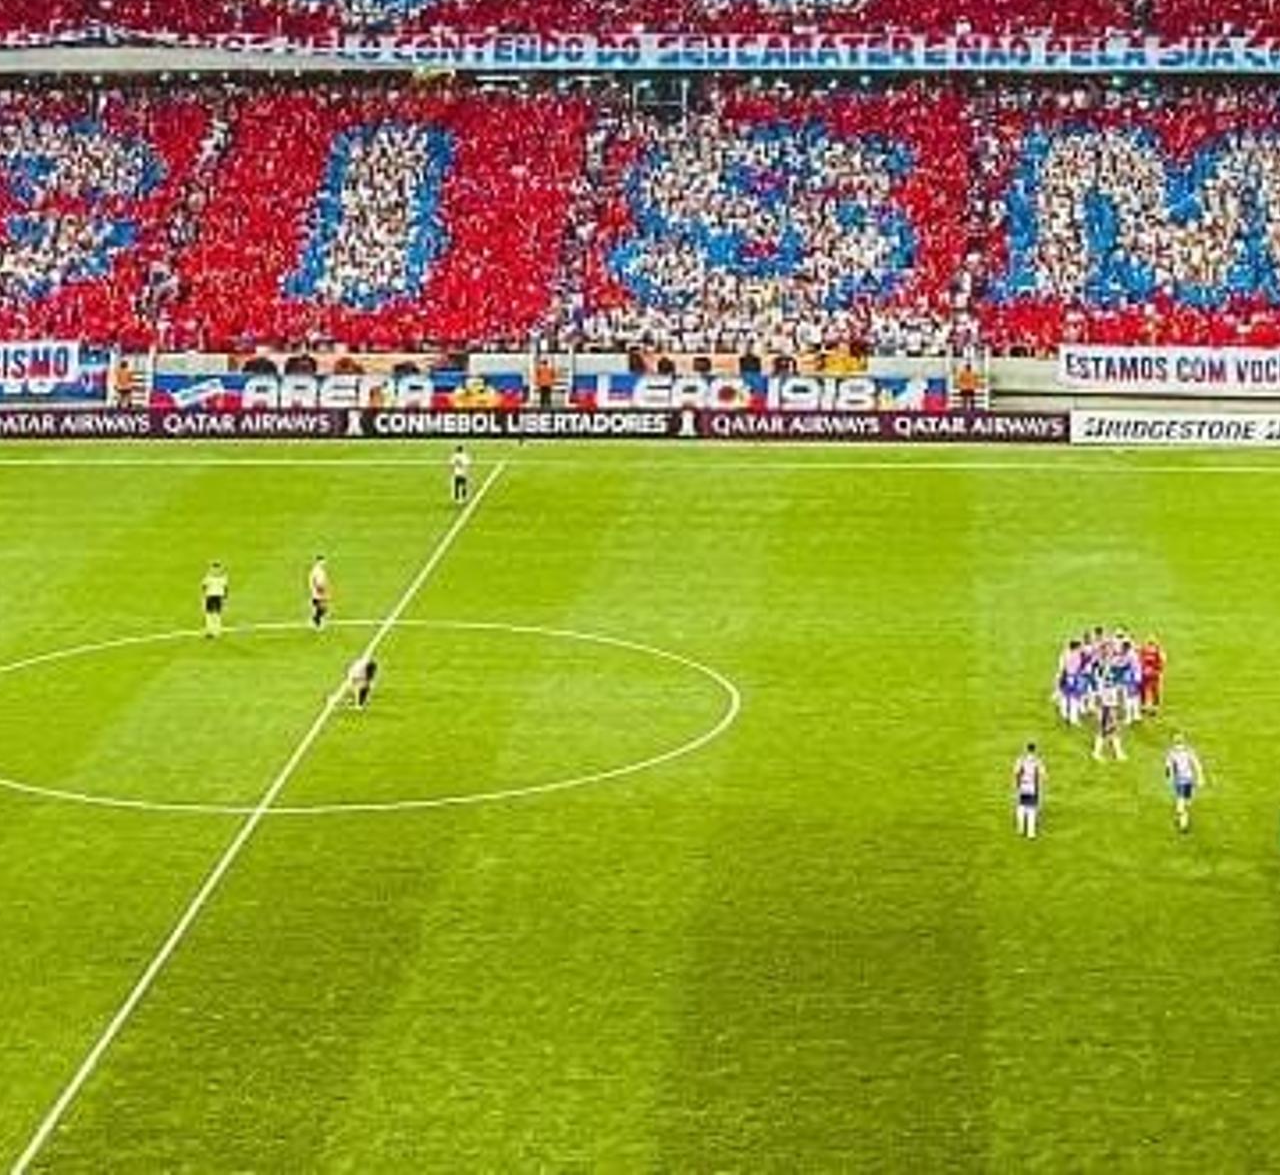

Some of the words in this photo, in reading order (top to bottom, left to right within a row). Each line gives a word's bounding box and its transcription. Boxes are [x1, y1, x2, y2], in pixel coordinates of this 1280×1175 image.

[1066, 352, 1167, 382] ESTAMOS
[1176, 355, 1227, 382] COM
[767, 375, 873, 410] 1918
[59, 413, 151, 434] AIRWAYS
[163, 413, 235, 435] QATAR
[240, 413, 330, 434] AIRWAYS
[375, 413, 501, 434] CONMEBOL
[508, 413, 668, 434] LIBERTADORES
[713, 416, 784, 437] QATAR
[788, 416, 881, 435] AIRWAYS
[893, 416, 967, 437] QATAR
[970, 416, 1064, 437] AIRWAYS
